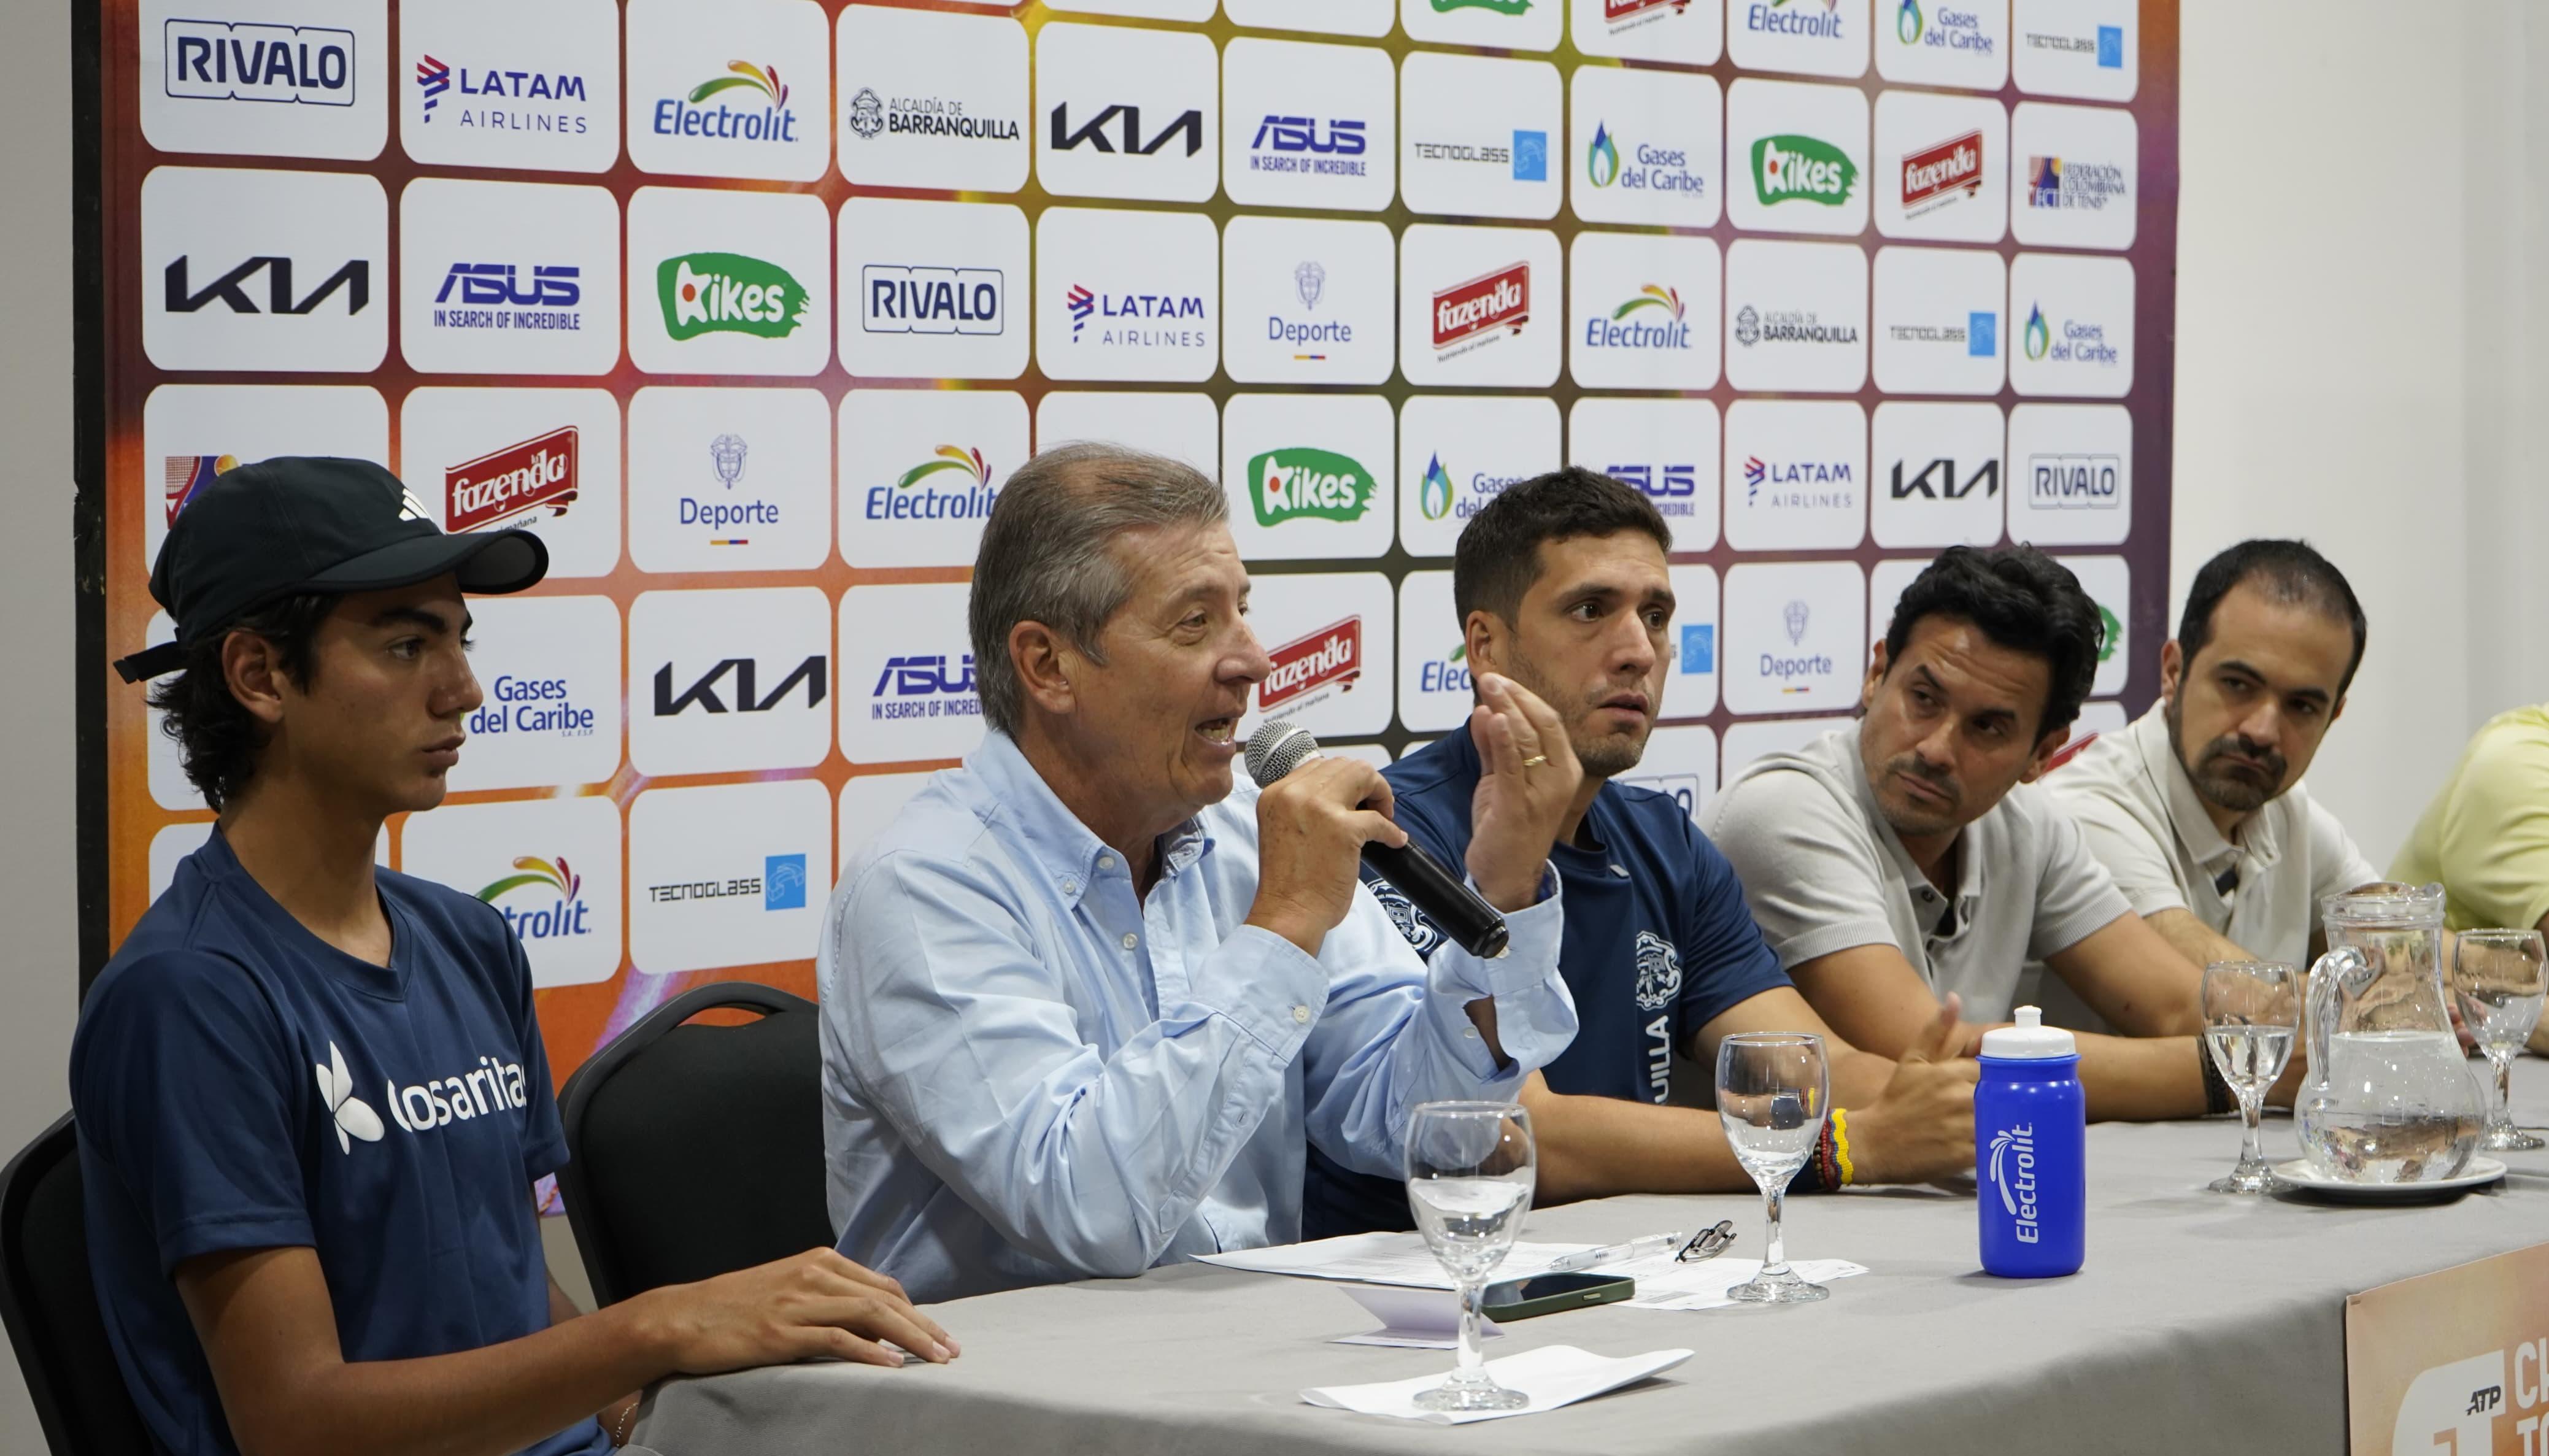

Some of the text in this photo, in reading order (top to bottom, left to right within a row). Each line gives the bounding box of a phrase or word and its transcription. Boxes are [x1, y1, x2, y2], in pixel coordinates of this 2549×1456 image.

[1748, 4, 1843, 38] Electrolit
[1938, 7, 1978, 28] Gases
[1924, 28, 1992, 52] del Caribe
[177, 36, 347, 89] RIVALO
[461, 68, 586, 102] LATAM
[890, 96, 962, 115] ALCALDÍA DE
[460, 110, 587, 134] AIRLINES
[654, 99, 798, 142] Electrolit
[889, 114, 1020, 141] BARRANQUILLA
[1251, 115, 1366, 155] ASUS
[1251, 156, 1367, 177] IN SEARCH OF INCREDIBLE
[1637, 145, 1686, 166] Gases
[1622, 168, 1703, 192] del Caribe
[434, 263, 580, 306] ASUS
[872, 280, 996, 321] RIVALO
[1103, 295, 1204, 318] LATAM
[434, 310, 580, 330] IN SEARCH OF INCREDIBLE
[1269, 317, 1351, 346] Deporte
[2064, 320, 2103, 339] Gases
[1103, 330, 1205, 347] AIRLINES
[1586, 318, 1690, 349] Electrolit
[1764, 325, 1857, 343] BARRANQUILLA
[2051, 342, 2117, 364] del Caribe
[1772, 463, 1851, 483] LATAM
[2036, 466, 2115, 497] RIVALO
[681, 498, 779, 530] Deporte
[1772, 495, 1851, 508] AIRLINES
[873, 655, 977, 696] ASU
[1760, 653, 1831, 680] Deporte
[494, 676, 566, 702] Gases
[471, 703, 593, 734] del Caribe
[873, 698, 981, 720] IN SEARCH OF INCRED
[2011, 1122, 2039, 1244] Electrolit
[2466, 1385, 2501, 1416] ATP
